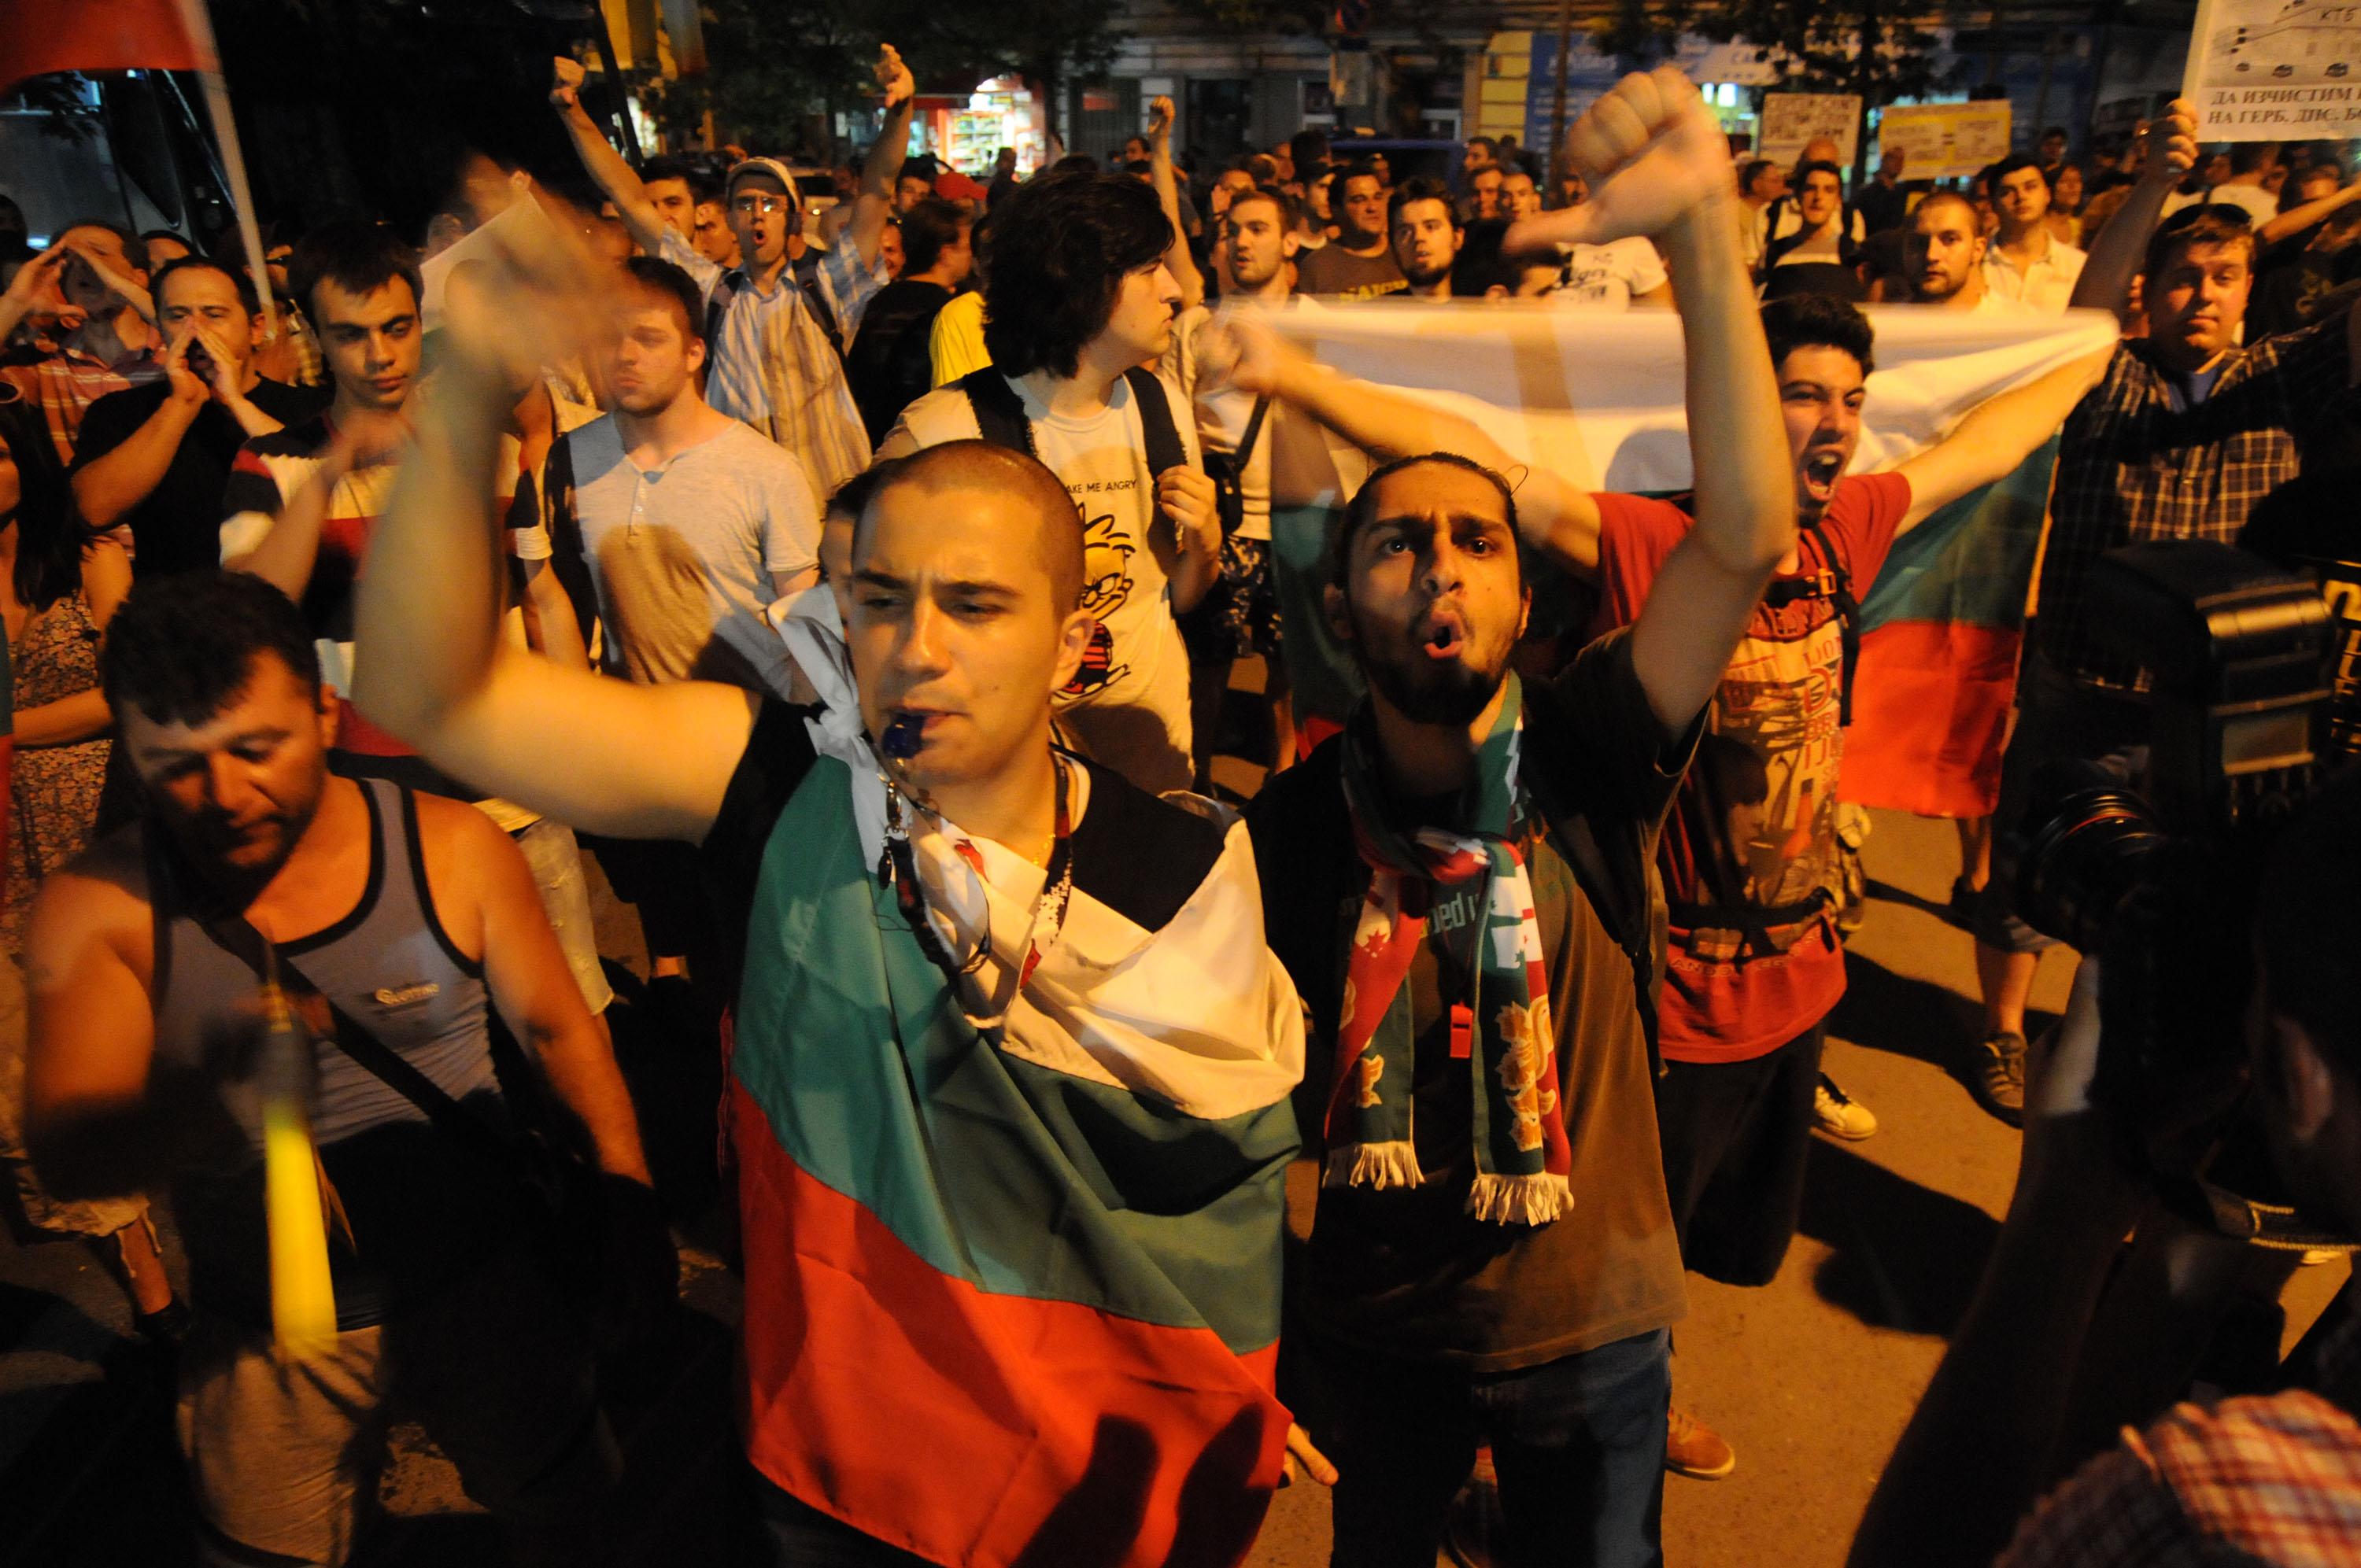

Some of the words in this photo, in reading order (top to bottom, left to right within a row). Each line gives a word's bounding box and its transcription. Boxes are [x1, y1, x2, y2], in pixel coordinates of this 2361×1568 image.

[2211, 90, 2237, 105] ДА
[2242, 87, 2353, 104] ИЗЧИСТИМ
[2208, 111, 2234, 124] НА
[1066, 484, 1082, 494] AKE
[1086, 482, 1101, 493] ME
[1106, 479, 1137, 491] ANGRY
